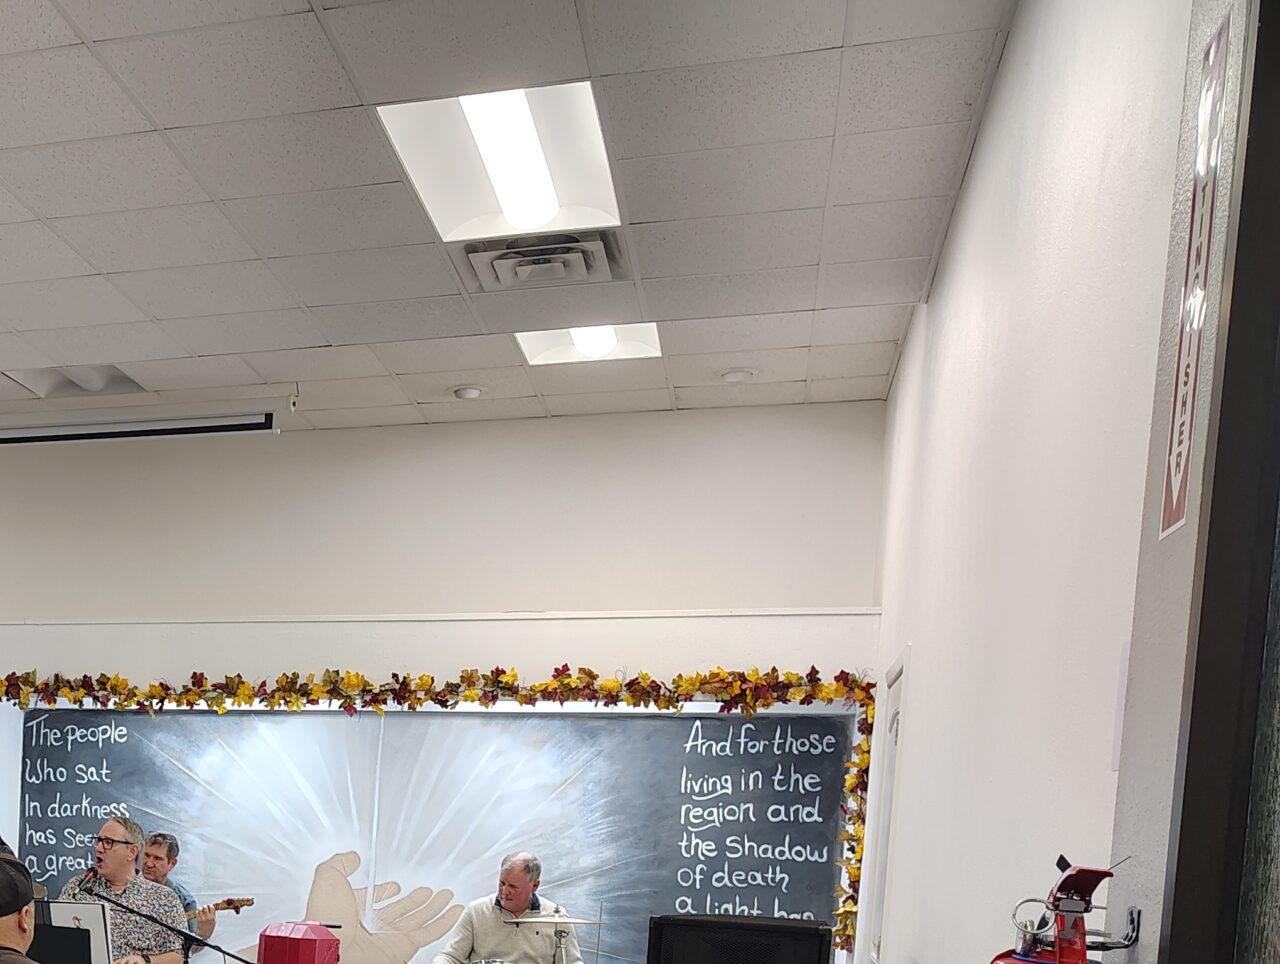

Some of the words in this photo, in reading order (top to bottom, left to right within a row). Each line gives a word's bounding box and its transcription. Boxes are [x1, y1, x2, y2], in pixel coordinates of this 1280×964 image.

[26, 713, 64, 747] The
[63, 719, 128, 752] people
[683, 719, 733, 757] And
[736, 722, 768, 754] for
[771, 724, 837, 754] those
[25, 756, 67, 784] Who
[75, 758, 112, 784] sat
[680, 765, 733, 800] living
[740, 768, 763, 791] in
[771, 762, 822, 794] the
[25, 793, 42, 818] In
[47, 793, 130, 819] darkness
[680, 802, 756, 832] region
[767, 796, 824, 824] and
[25, 823, 57, 846] has
[677, 832, 718, 859] the
[25, 855, 41, 873] a
[35, 852, 95, 882] great
[711, 861, 790, 893] death
[675, 896, 697, 914] a
